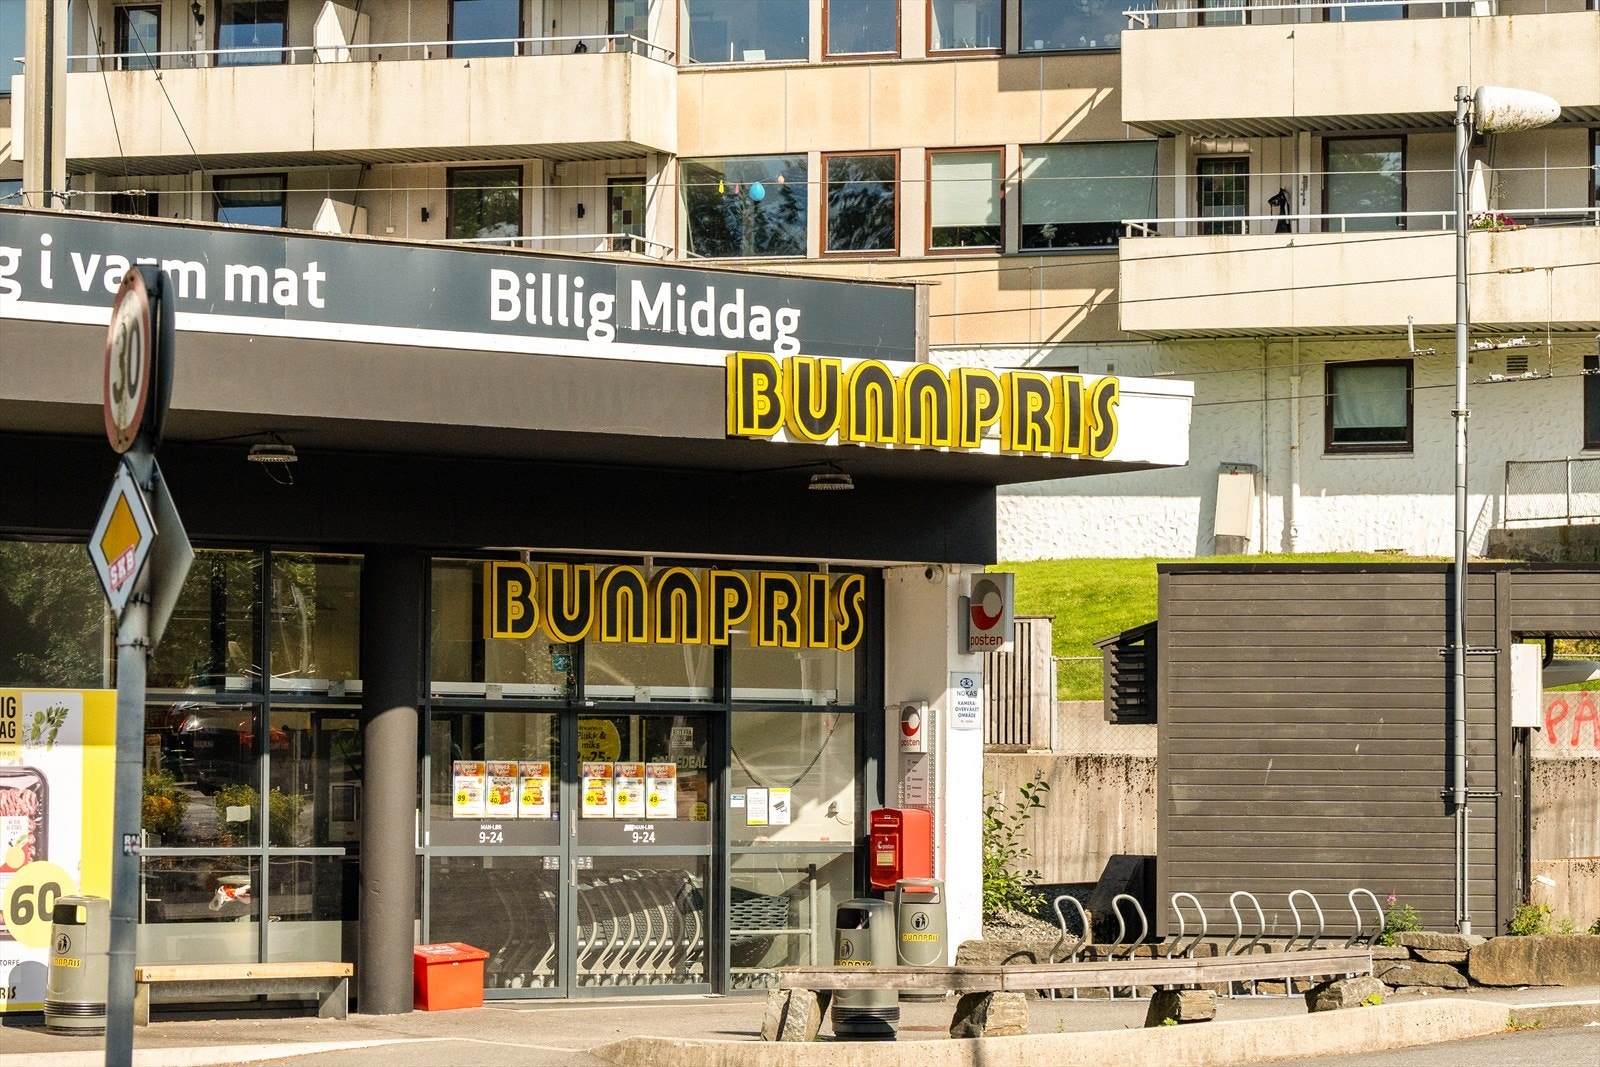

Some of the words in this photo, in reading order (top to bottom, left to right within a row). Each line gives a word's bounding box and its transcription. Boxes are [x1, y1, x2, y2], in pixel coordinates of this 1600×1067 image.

[40, 233, 53, 289] i
[70, 252, 206, 299] vam
[224, 261, 326, 308] mat
[490, 268, 615, 343] Billig
[631, 280, 801, 355] Middag
[112, 317, 141, 404] 30
[727, 351, 1120, 459] BUNNPRIS
[483, 561, 865, 651] BUNNPRIS
[970, 633, 1003, 646] posten
[0, 720, 16, 739] AG
[901, 738, 920, 747] posten
[457, 794, 466, 802] 99
[479, 831, 503, 844] 9-24
[632, 831, 656, 843] 9-24
[10, 882, 61, 925] 60
